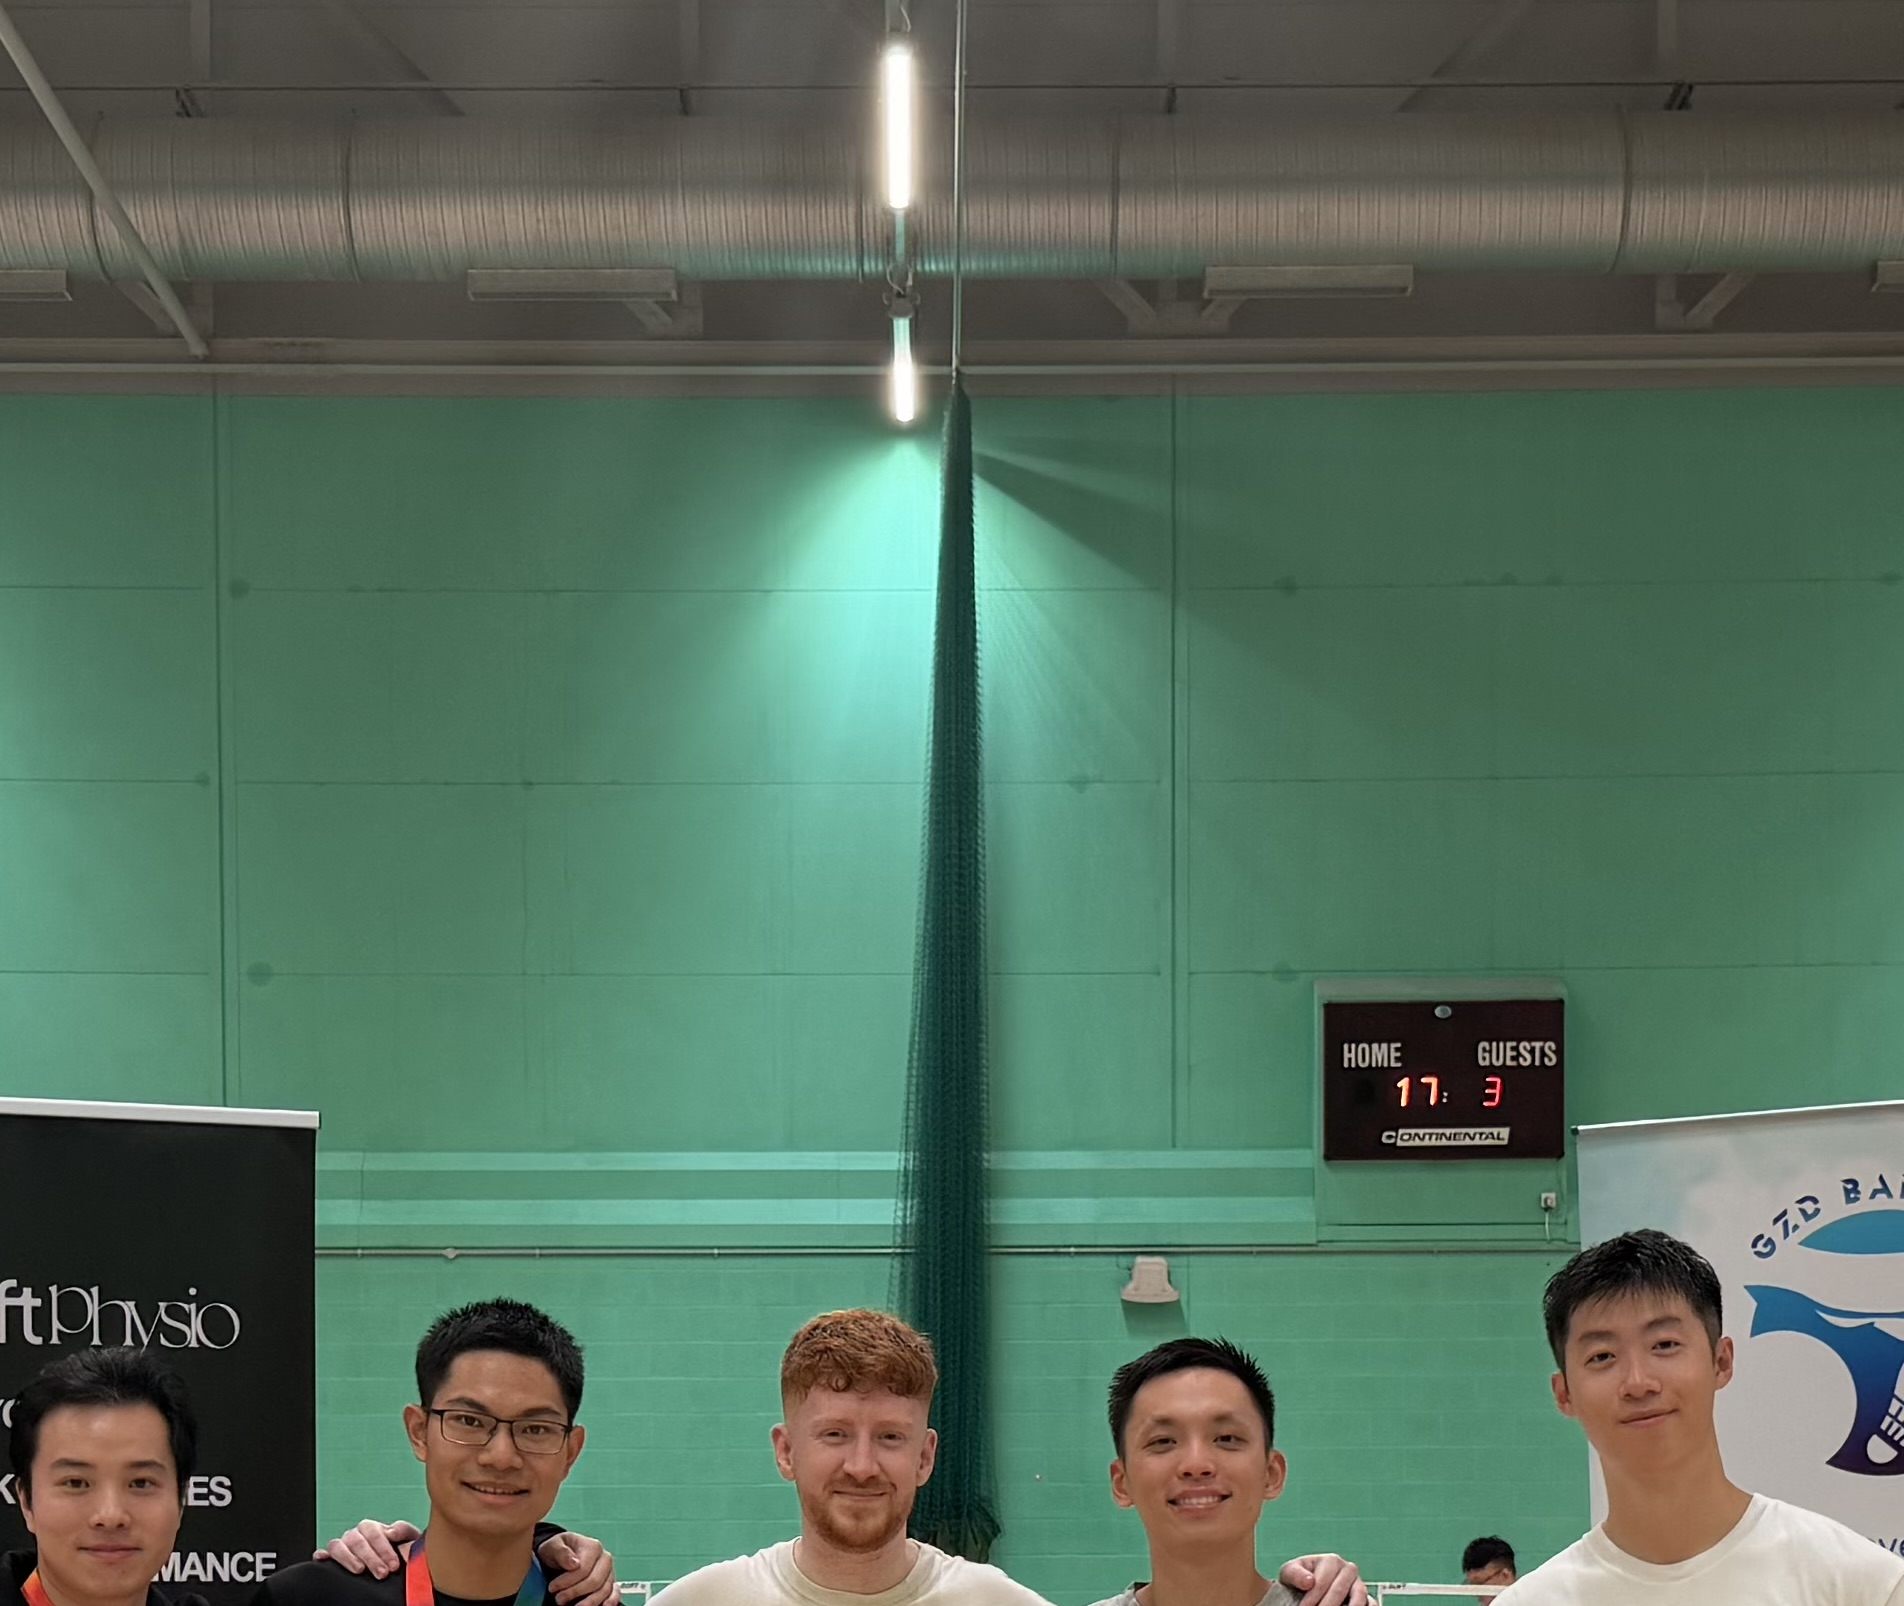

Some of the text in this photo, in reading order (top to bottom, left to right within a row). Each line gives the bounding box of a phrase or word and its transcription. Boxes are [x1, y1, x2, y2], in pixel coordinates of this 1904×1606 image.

[1344, 1041, 1556, 1068] HOME GUESTS
[1482, 1076, 1503, 1107] 3
[1381, 1127, 1510, 1147] CONTINENTAL
[1750, 1194, 1820, 1260] GZD
